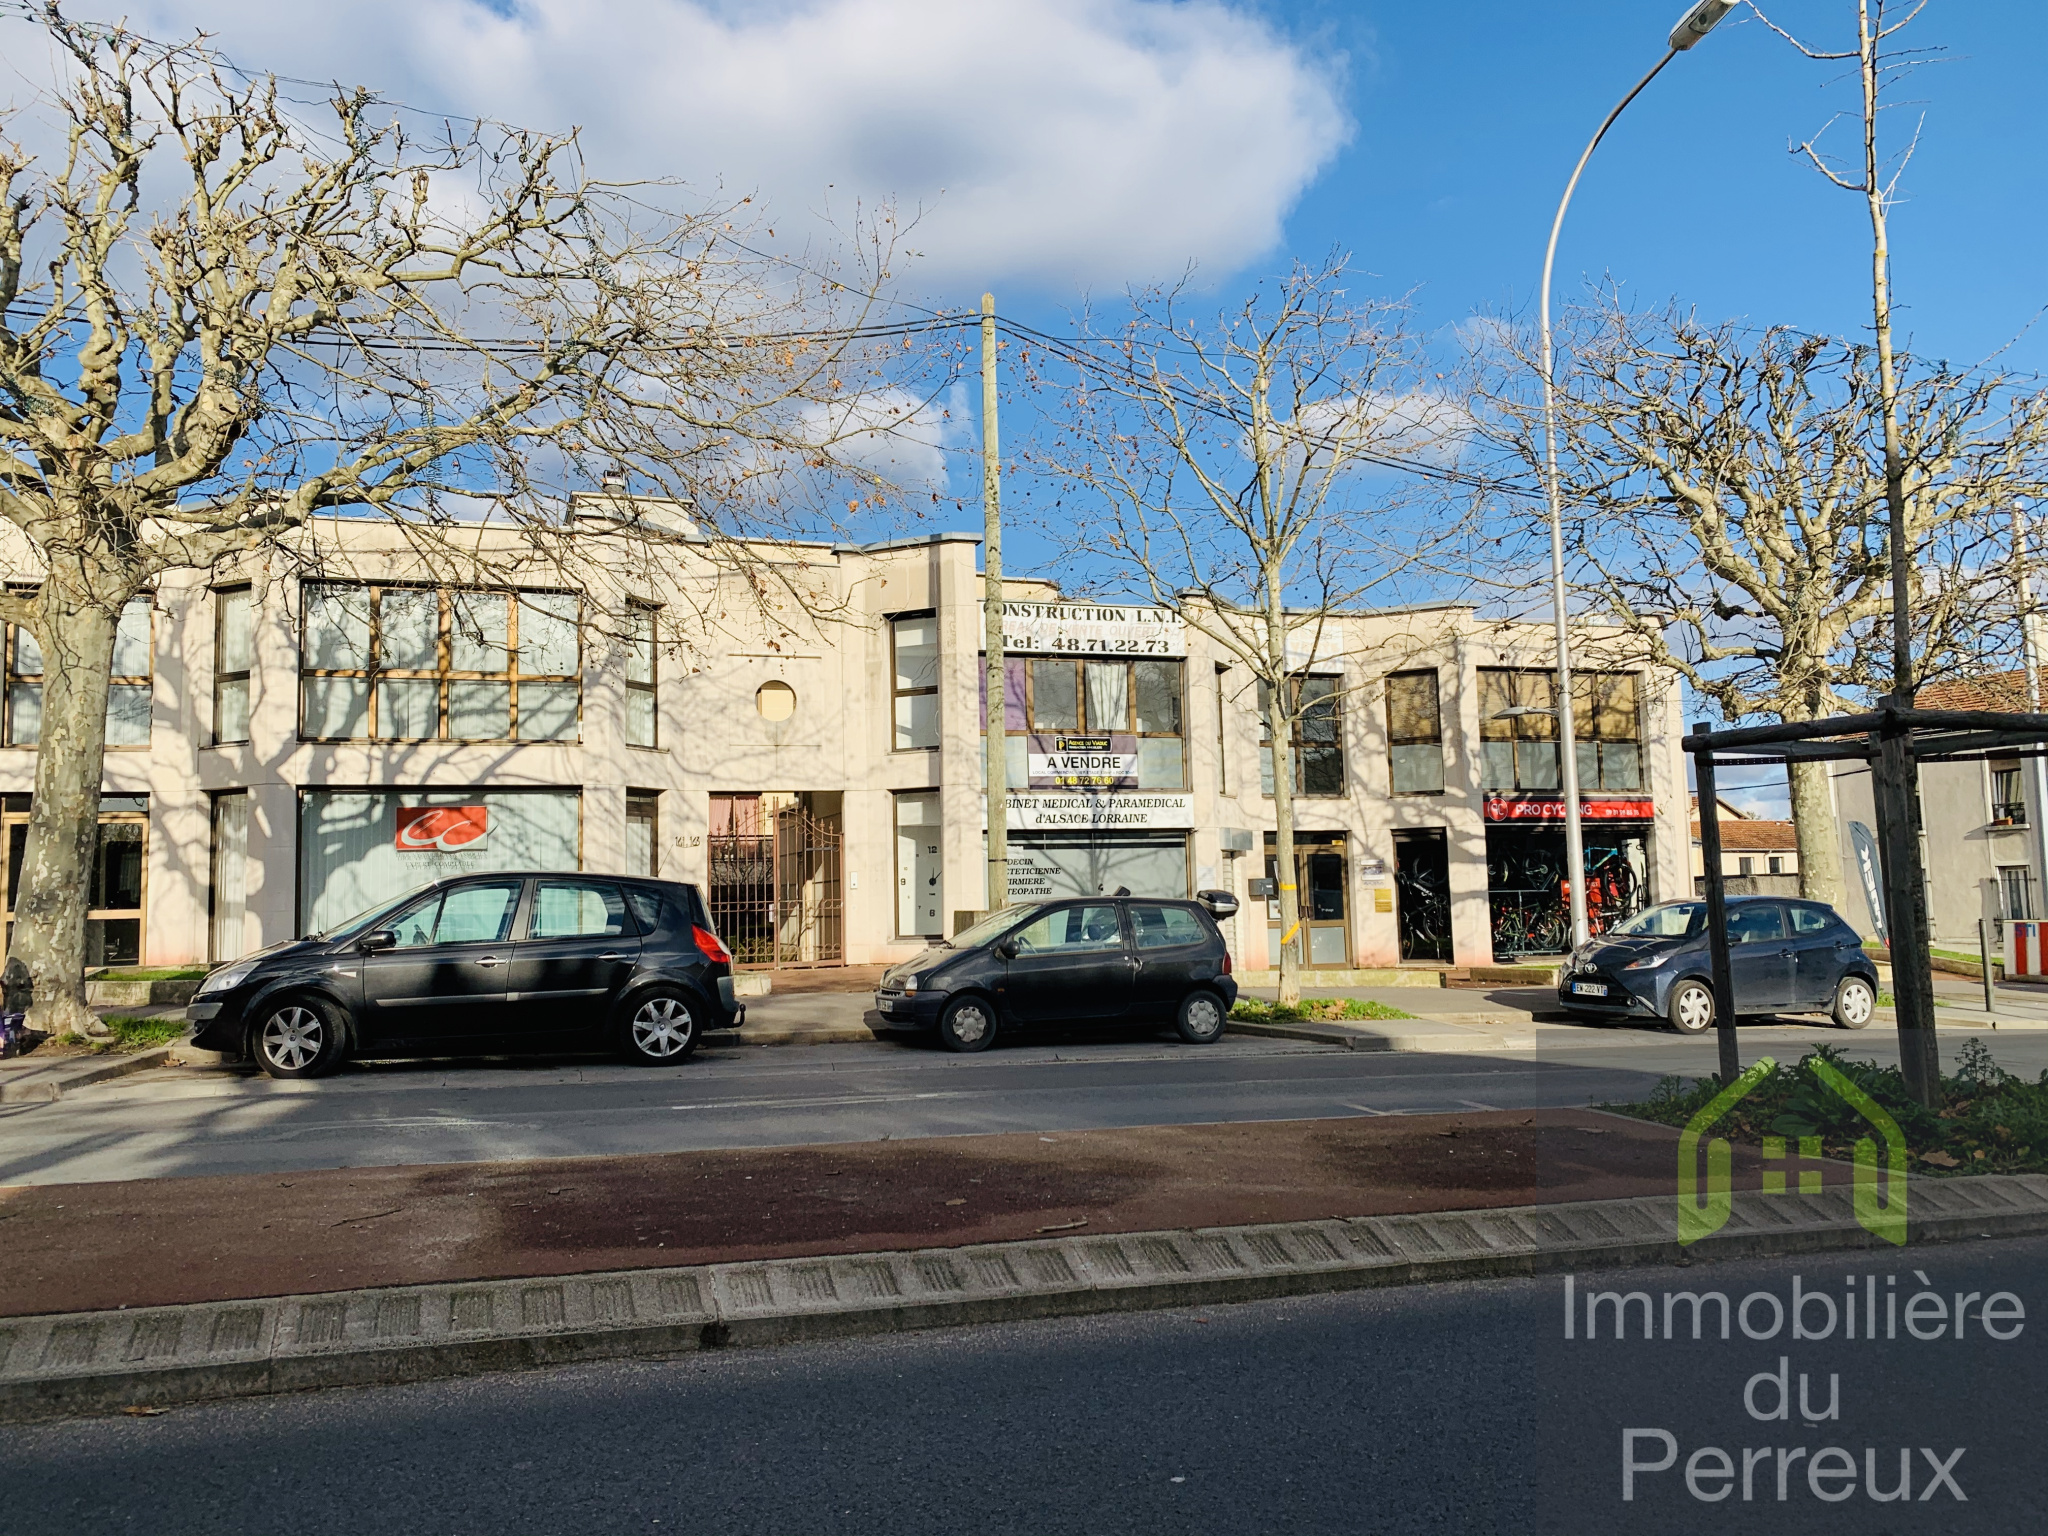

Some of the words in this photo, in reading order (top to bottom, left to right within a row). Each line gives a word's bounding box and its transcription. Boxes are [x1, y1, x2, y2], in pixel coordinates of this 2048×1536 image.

[983, 602, 1126, 622] NSTRUCTION
[1051, 638, 1169, 653] 48.71.22.73
[1047, 757, 1057, 768] A
[1061, 757, 1121, 768] VENDRE
[1006, 798, 1039, 808] BINET
[1042, 799, 1092, 808] MEDICAL
[1095, 799, 1106, 808] &
[1109, 799, 1186, 808] PARAMEDICAL
[1516, 803, 1541, 816] PRO
[1543, 803, 1593, 816] CYCNG
[1036, 814, 1089, 823] d'ALSACE
[1092, 814, 1148, 823] LORRAINE
[927, 845, 938, 854] 12
[1007, 858, 1034, 866] DECIN
